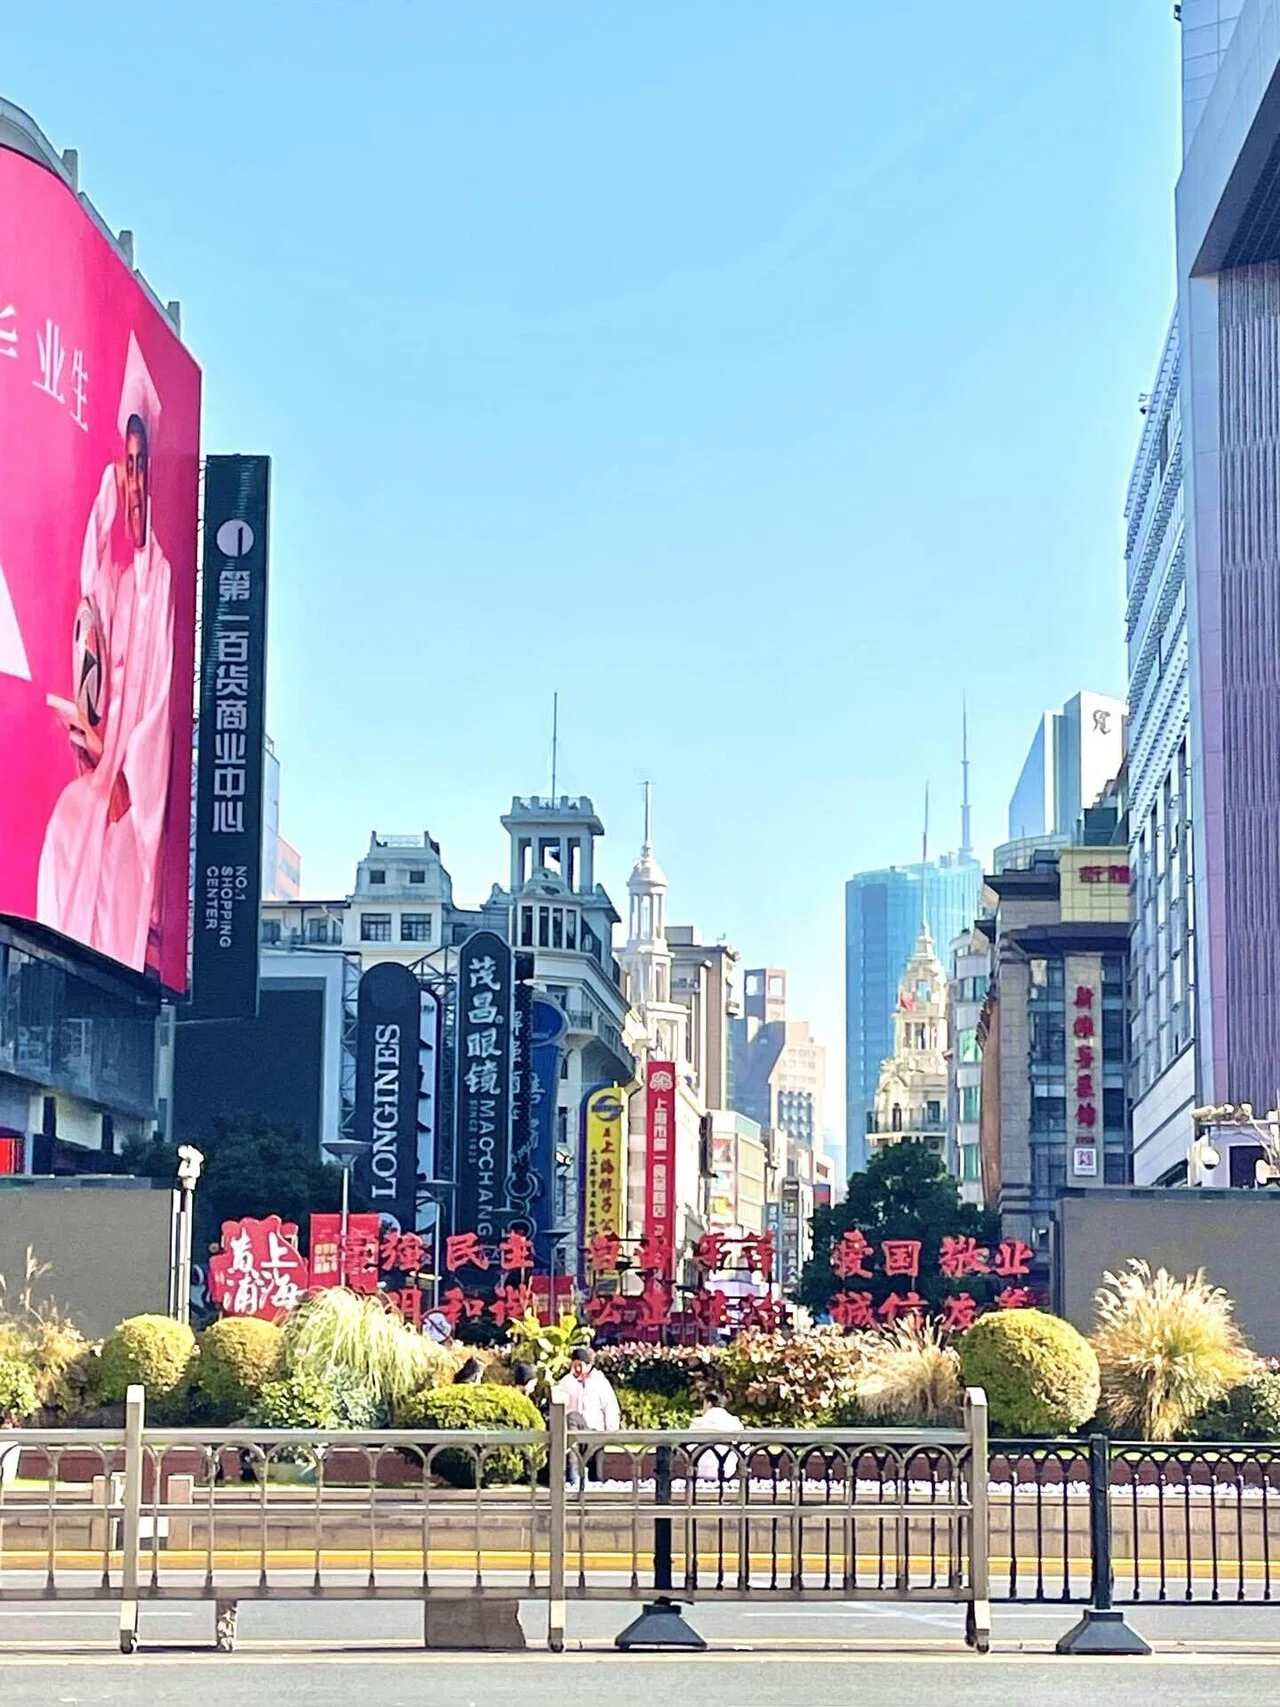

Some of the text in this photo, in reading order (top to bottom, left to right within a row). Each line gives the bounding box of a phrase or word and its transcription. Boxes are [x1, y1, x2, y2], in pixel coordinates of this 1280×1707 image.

[212, 570, 250, 832] 第一百货商业中心
[205, 865, 219, 930] CENTER
[219, 865, 234, 948] SHOPPING
[464, 956, 502, 1094] 茂昌眼镜
[371, 1024, 400, 1199] LONGINES
[260, 1231, 301, 1309] 上海
